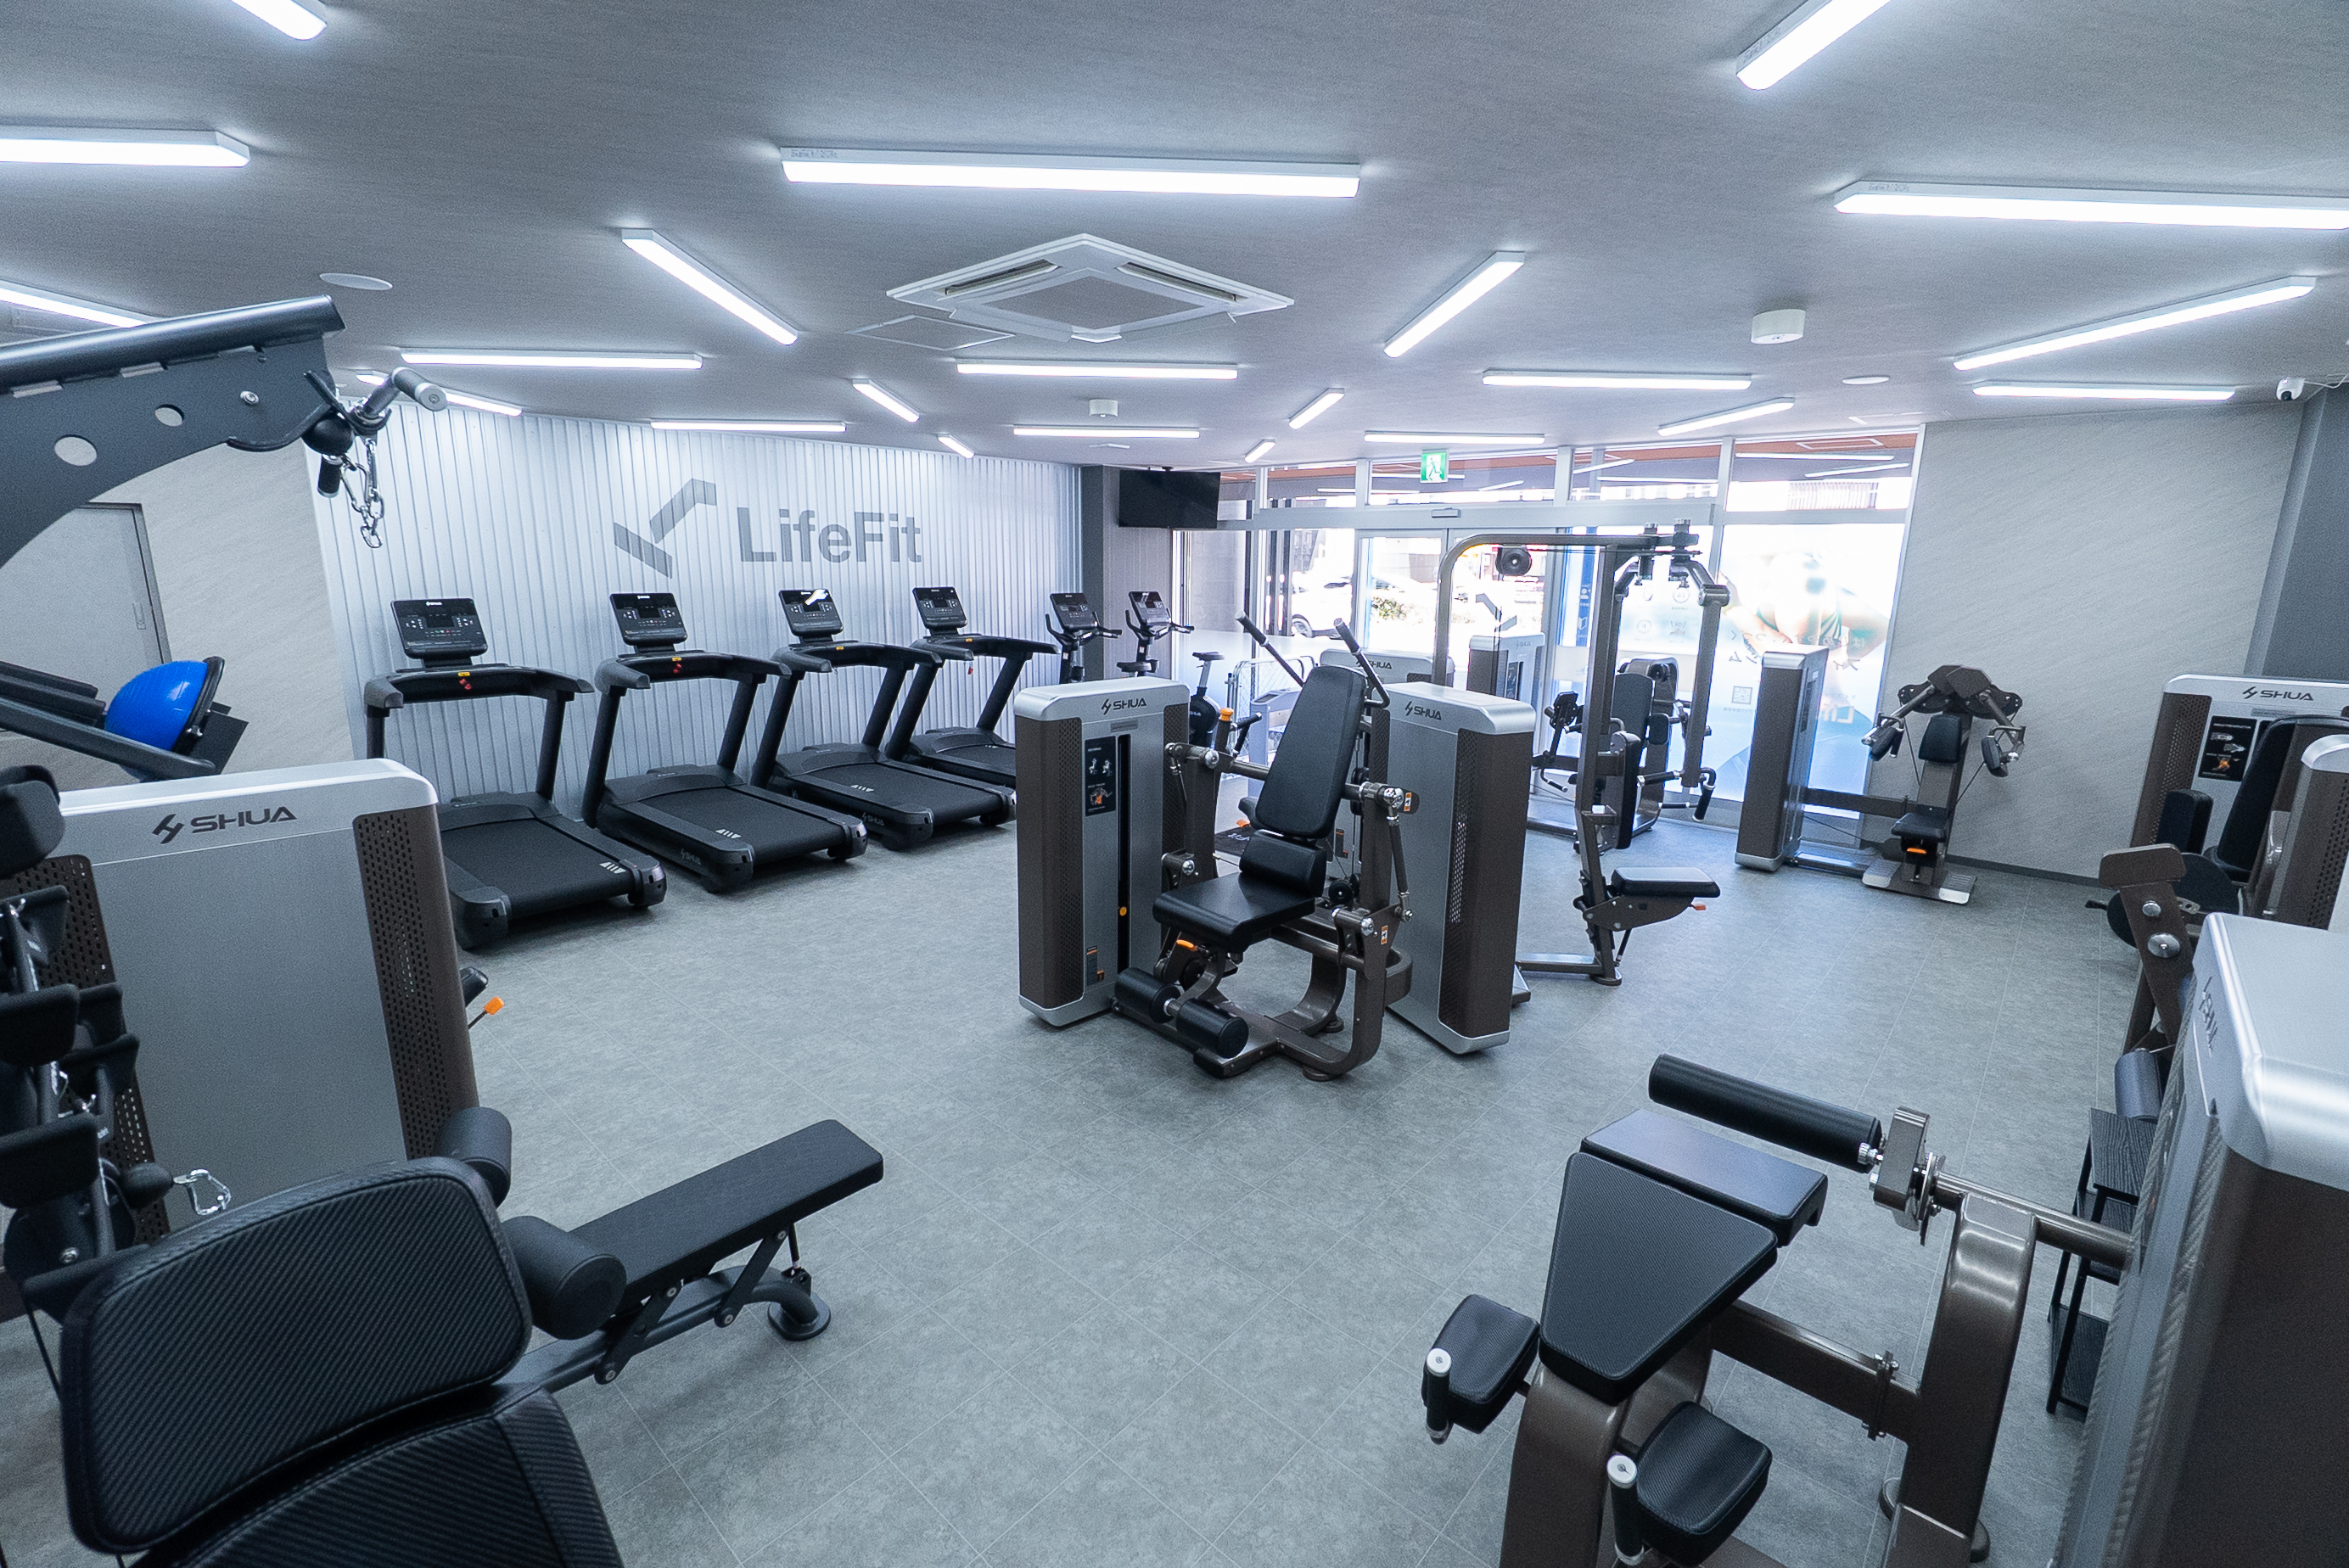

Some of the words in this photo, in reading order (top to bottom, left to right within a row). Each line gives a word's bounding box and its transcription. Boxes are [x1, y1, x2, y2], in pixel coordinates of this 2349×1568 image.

[737, 507, 922, 563] LifeFit
[2259, 689, 2314, 701] SHUA
[1113, 697, 1147, 711] SHUA
[1413, 705, 1442, 721] SHUA
[190, 806, 298, 833] SHUA
